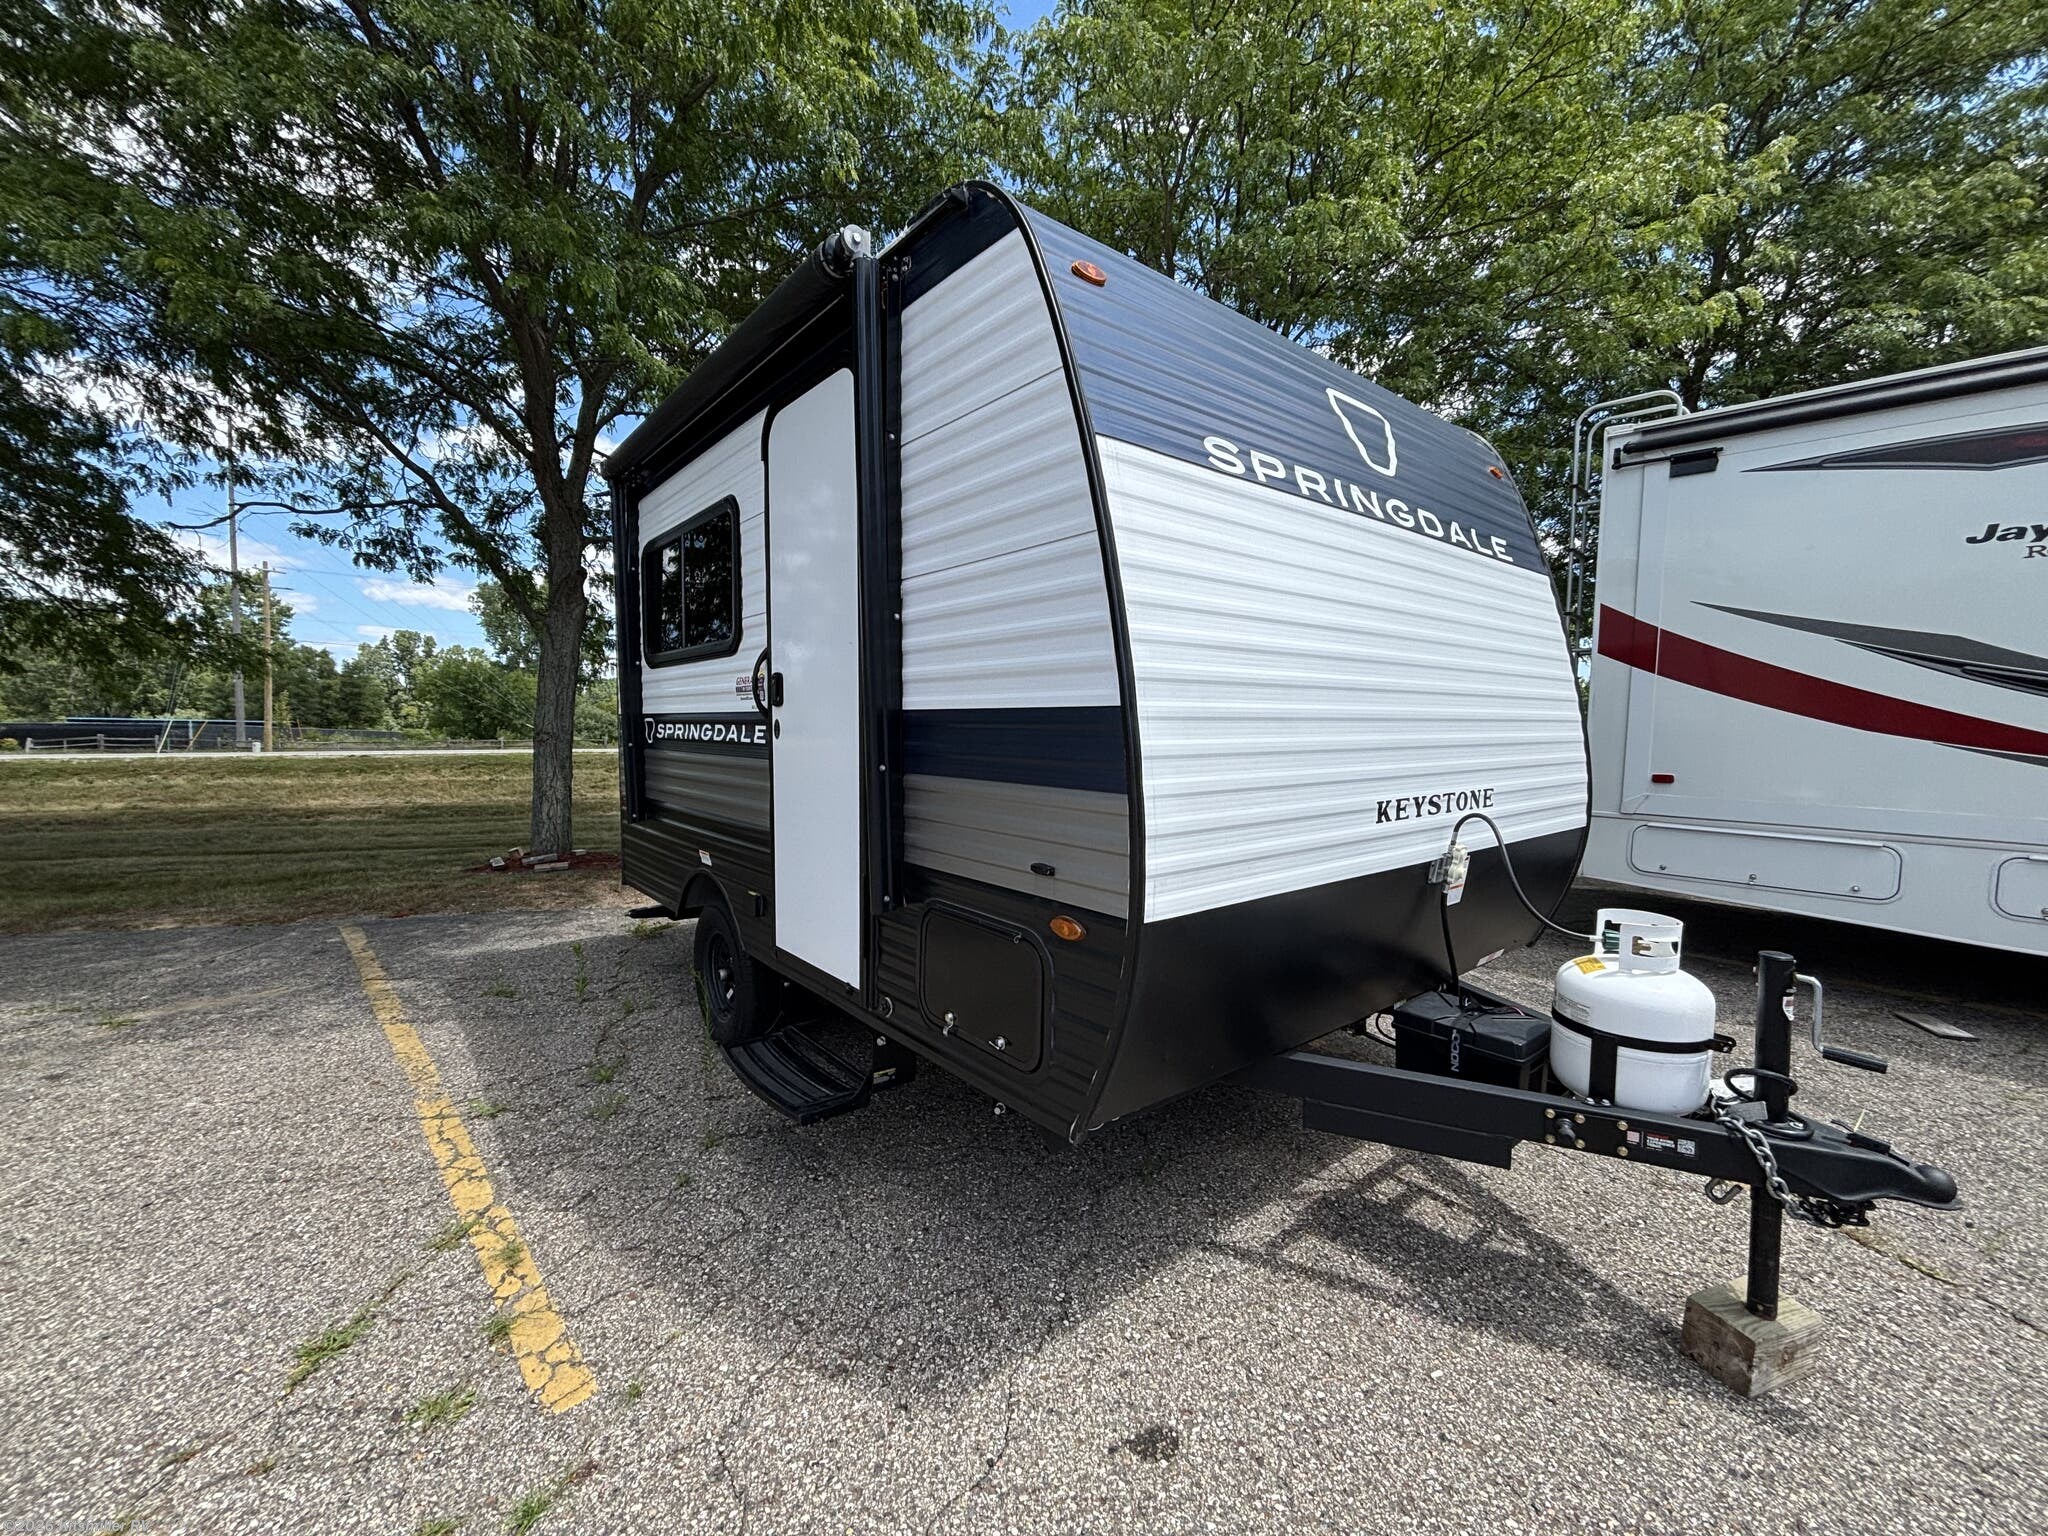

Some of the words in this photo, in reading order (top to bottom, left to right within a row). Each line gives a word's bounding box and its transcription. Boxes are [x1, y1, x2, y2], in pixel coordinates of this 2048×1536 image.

[1203, 436, 1513, 562] SPRINGDALE
[656, 723, 767, 744] SPRINGDALE
[1375, 788, 1495, 824] KEYSTONE
